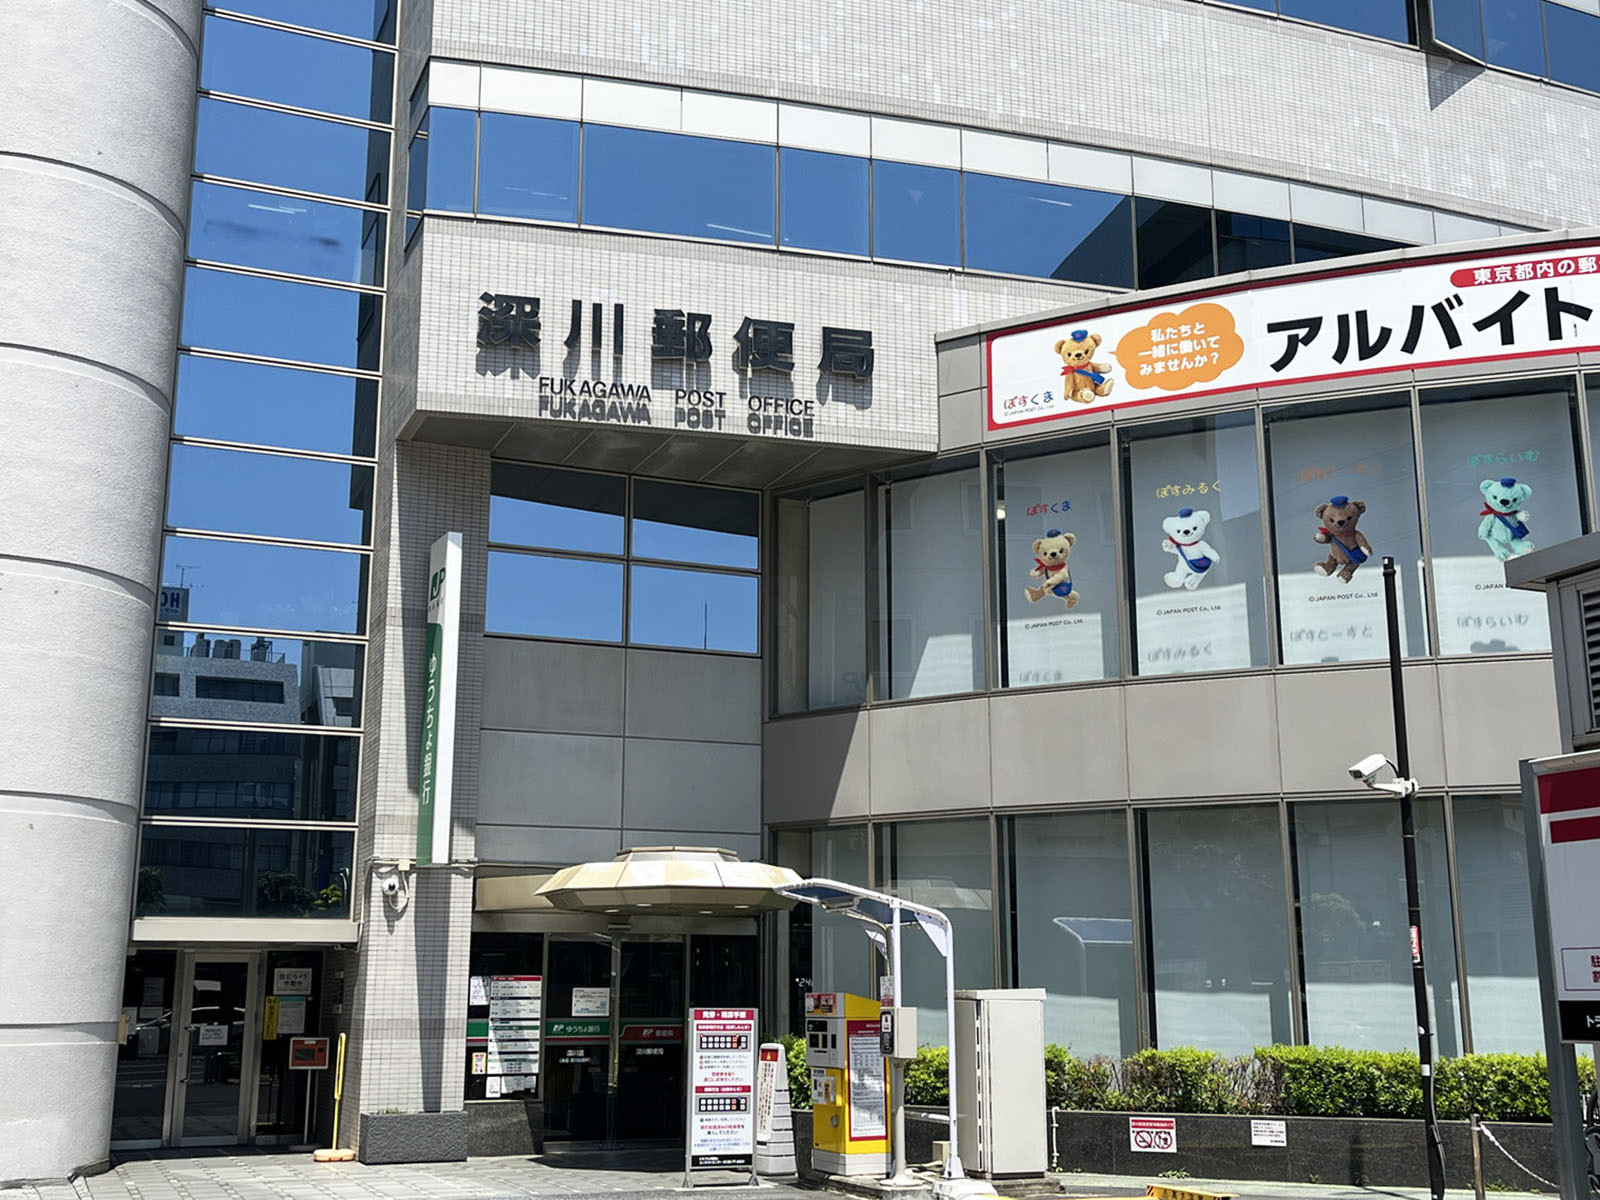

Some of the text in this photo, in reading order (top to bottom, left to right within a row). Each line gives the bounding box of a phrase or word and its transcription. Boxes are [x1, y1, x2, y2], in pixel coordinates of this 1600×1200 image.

[476, 291, 875, 379] 深川郵便局
[1151, 322, 1205, 342] 私たちと
[1267, 286, 1593, 373] アルバイト
[1138, 335, 1220, 359] 一緒に働いて
[1140, 352, 1219, 376] みませんか？
[539, 377, 815, 416] FUKAGAWA POST OFFICE
[1003, 390, 1054, 410] ぽすくま
[1156, 480, 1221, 499] ぽすみるく
[1027, 500, 1072, 517] ぽすくま
[1031, 621, 1048, 629] JAPAN
[422, 652, 437, 805] ゆうちょ銀行
